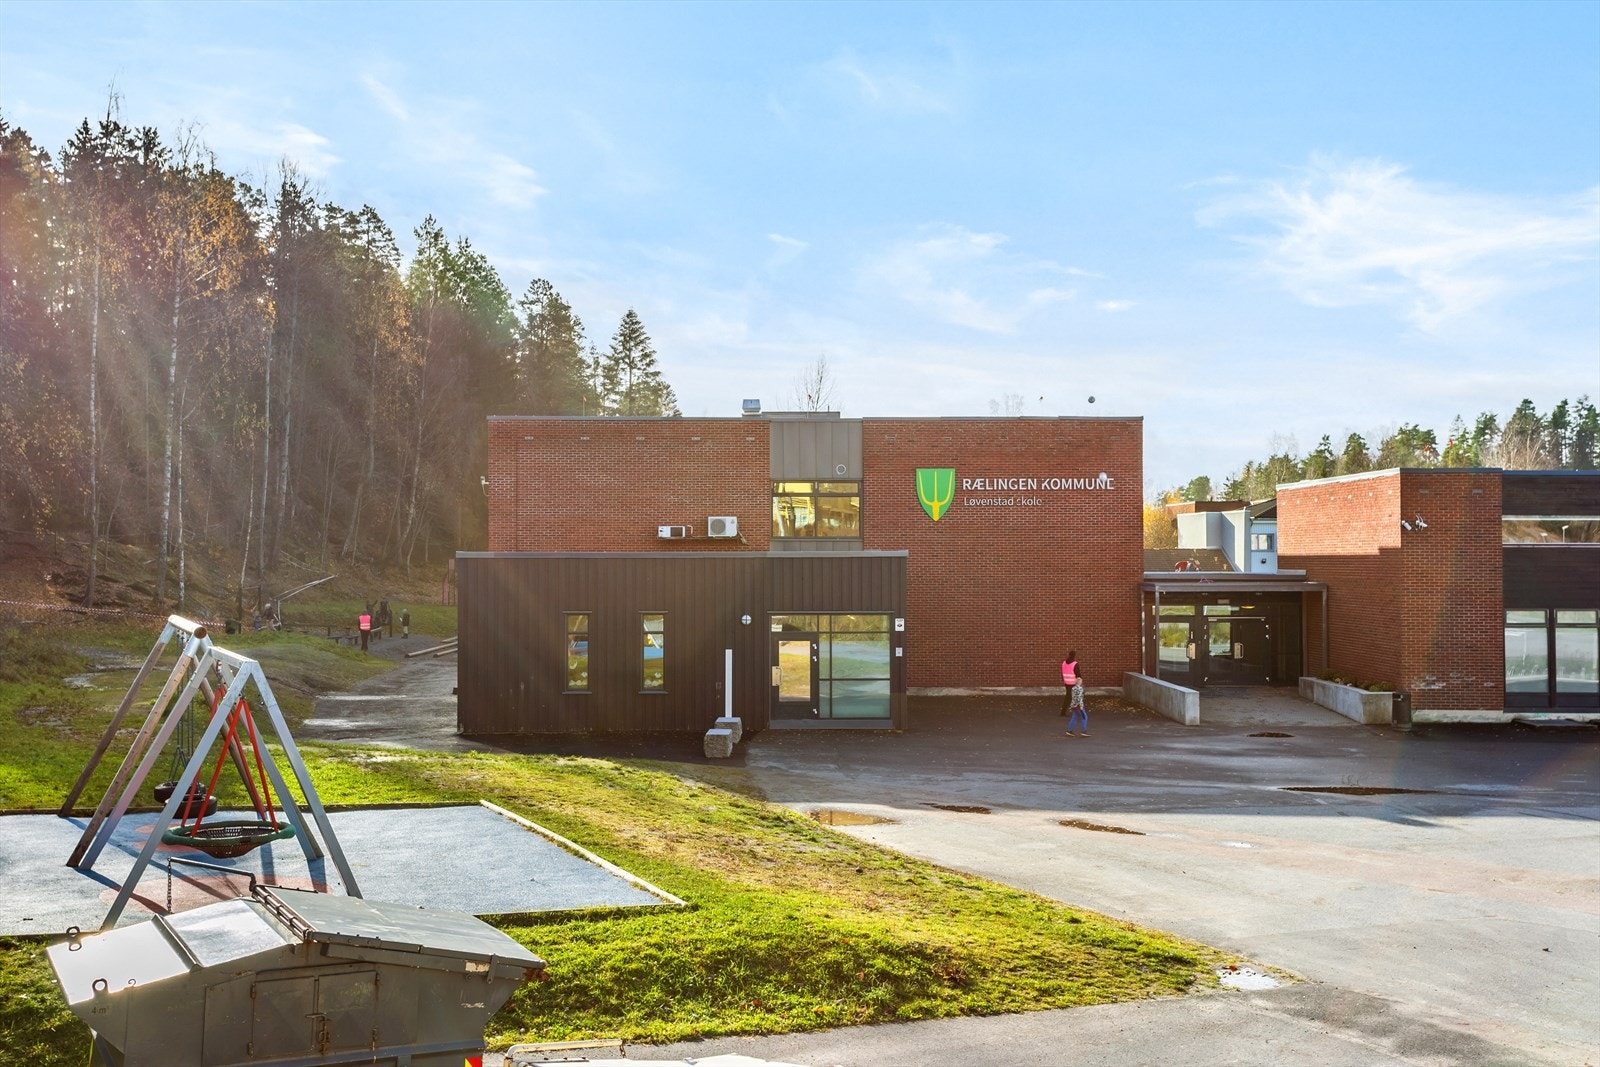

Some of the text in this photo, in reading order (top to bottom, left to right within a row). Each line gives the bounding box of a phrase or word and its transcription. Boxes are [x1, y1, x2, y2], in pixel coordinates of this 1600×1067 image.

[962, 478, 1115, 490] RÆLINGEN KOMMUNE
[964, 496, 1014, 506] Løvenstad
